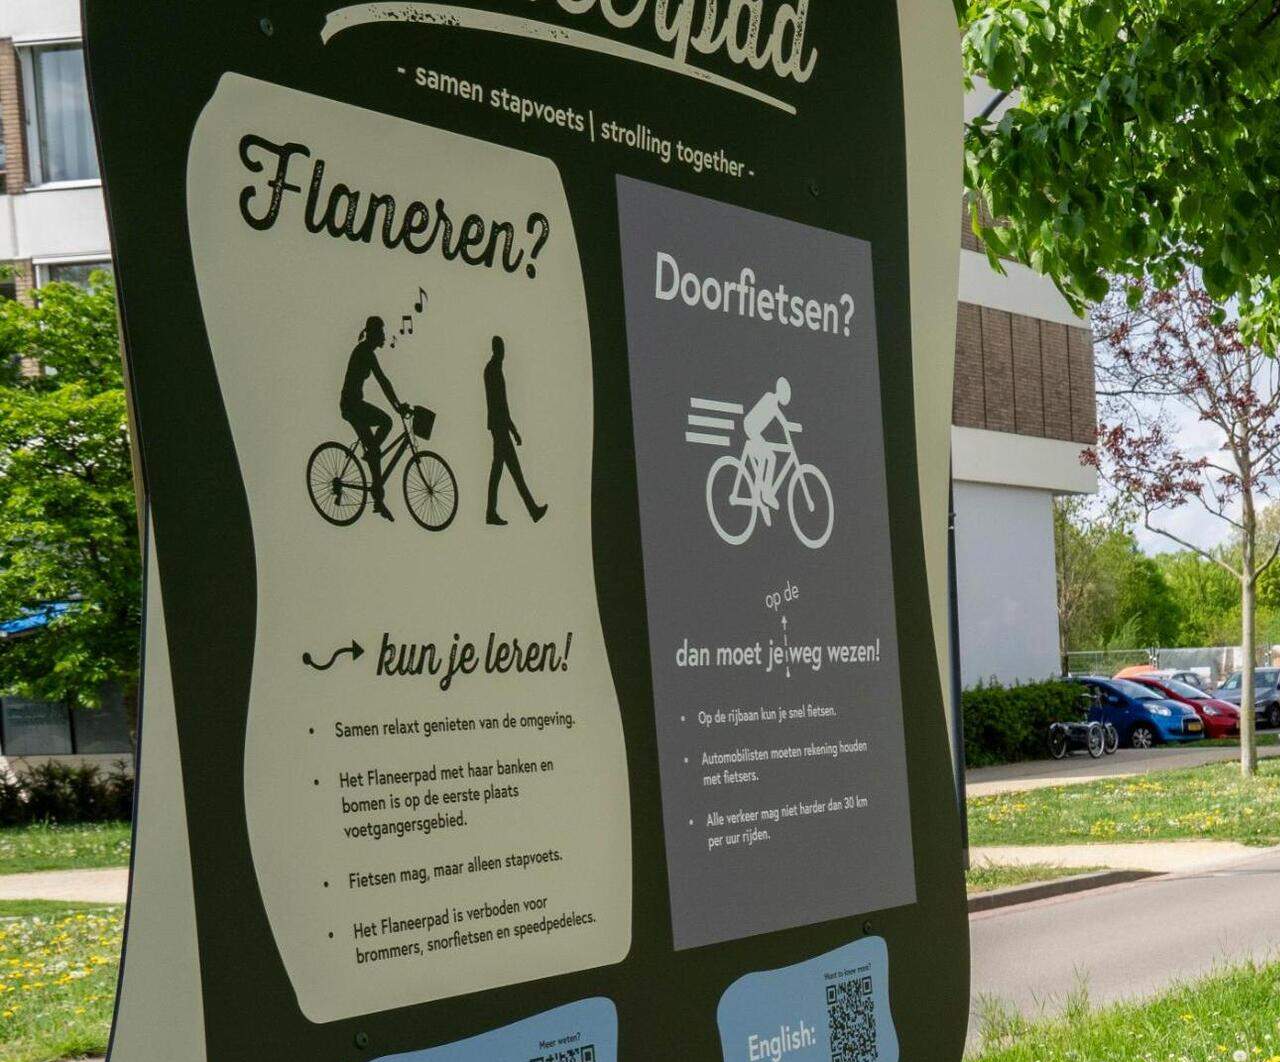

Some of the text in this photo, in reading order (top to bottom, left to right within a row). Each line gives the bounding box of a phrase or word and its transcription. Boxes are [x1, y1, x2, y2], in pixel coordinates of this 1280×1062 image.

[415, 63, 483, 103] samen
[490, 88, 584, 132] stapvoets
[601, 119, 671, 163] strolling
[677, 141, 744, 178] together
[239, 134, 549, 279] Flaneren?
[655, 251, 855, 337] Doorfietsen?
[765, 581, 799, 611] op de
[377, 632, 573, 691] kun je leren!
[676, 638, 880, 672] dan moet je weg wezen!
[335, 711, 575, 737] Samen relaxt genieten van de omgeving.
[698, 704, 837, 727] Op de rijbaan kun je snel fietsen.
[701, 739, 867, 766] Automobilisten moeten rekening houden
[339, 758, 553, 788] Het Flaneerpad met haar banken en
[703, 770, 759, 786] met fietsers.
[342, 784, 519, 813] bomen is op de eerste plaats
[706, 795, 868, 827] Alle verkeer mag niet harder dan 30 km
[344, 811, 467, 840] voetgangersgebied.
[708, 827, 771, 850] per uur rijden.
[349, 849, 563, 889] Fietsen mag, maar alleen stapvoets.
[353, 897, 548, 939] Het Flaneerpad is verboden voor
[356, 911, 596, 964] brommers, snorfietsen en speedpedelecs.
[748, 1020, 816, 1062] English:
